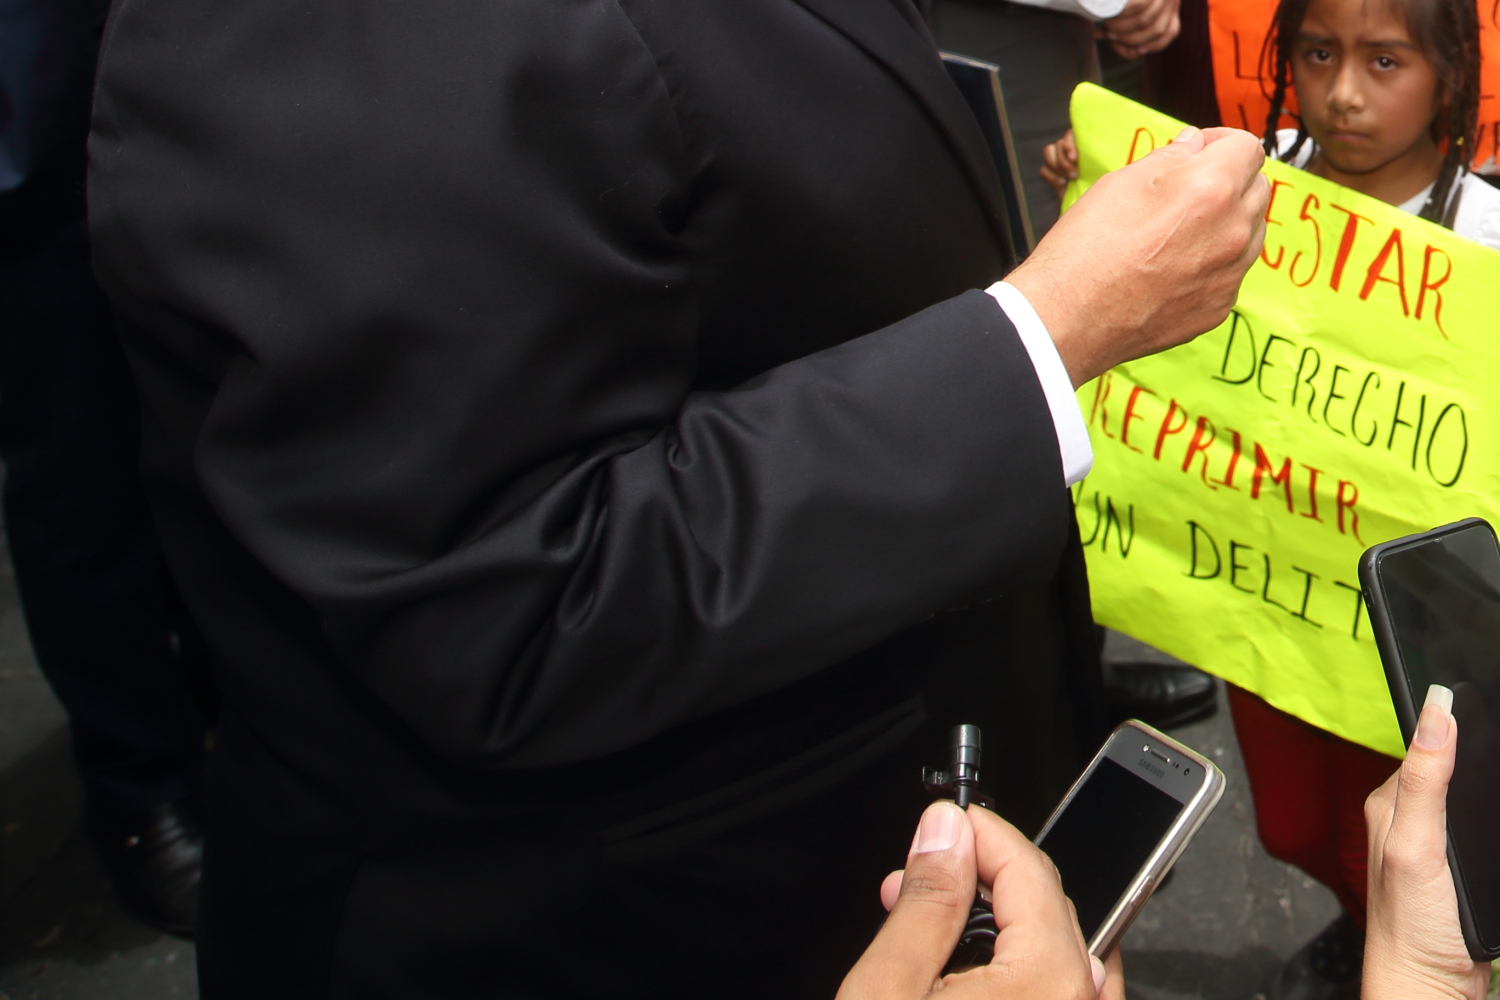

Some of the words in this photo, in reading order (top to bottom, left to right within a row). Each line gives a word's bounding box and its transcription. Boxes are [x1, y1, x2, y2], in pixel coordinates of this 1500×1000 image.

[1089, 370, 1368, 548] REPRIMIR
[1211, 308, 1470, 489] DERECHO
[1179, 519, 1364, 642] DELIT
